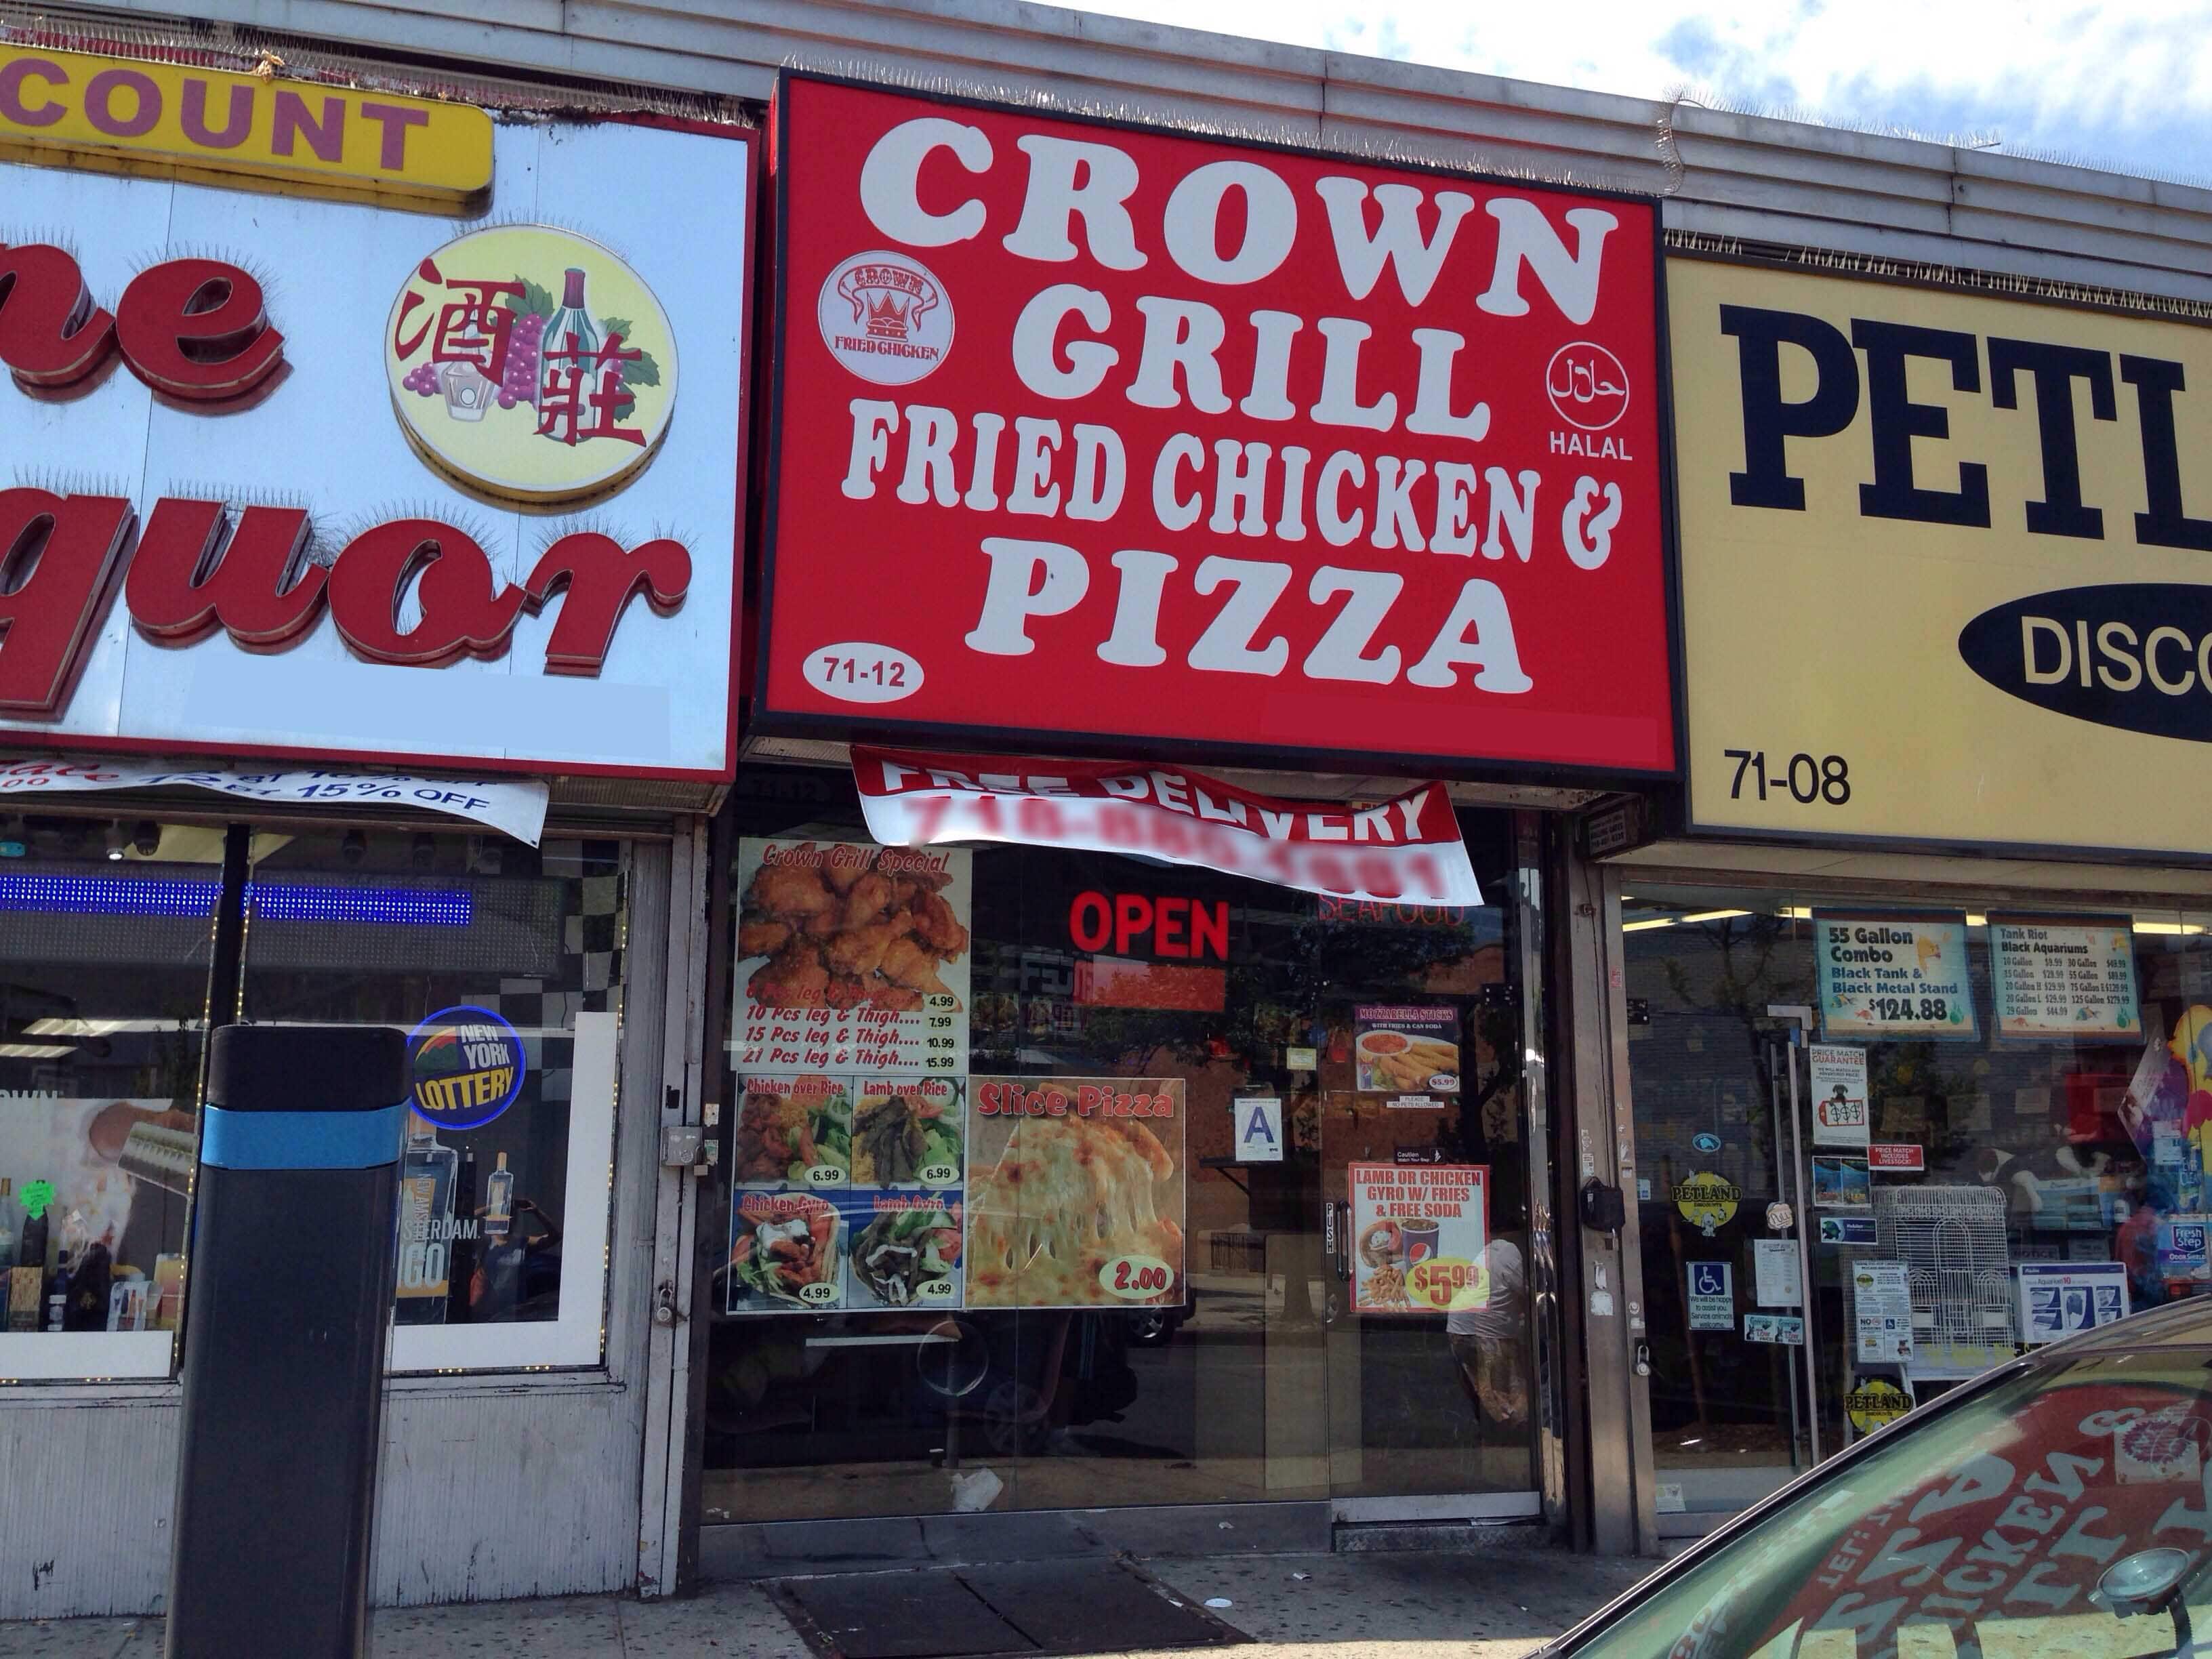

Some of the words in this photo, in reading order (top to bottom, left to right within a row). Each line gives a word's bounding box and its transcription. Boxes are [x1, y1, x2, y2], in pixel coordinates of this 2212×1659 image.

[0, 58, 428, 170] COUNT
[859, 117, 1619, 326] CROWN
[855, 268, 924, 294] CROWN
[835, 336, 876, 354] FRIED
[878, 341, 939, 361] CHICKEN
[1012, 283, 1491, 443] GRILL
[1550, 359, 1626, 403] حلال
[1550, 431, 1633, 461] HALAL
[842, 398, 1128, 522] FRIED
[1153, 432, 1541, 562] CHICKEN
[1562, 475, 1622, 571] &
[965, 536, 1534, 695] PIZZA
[822, 655, 906, 689] 71-12
[881, 760, 1080, 798] FREE
[1724, 750, 1851, 806] 71-08
[297, 783, 401, 799] 15%
[413, 789, 491, 810] OFF
[763, 844, 823, 868] Crown
[831, 845, 874, 869] Grill
[878, 848, 951, 877] Special
[1070, 890, 1229, 962] OPEN
[2001, 928, 2026, 939] Tank
[1829, 927, 1850, 944] 55
[1855, 927, 1914, 945] Gallon
[1830, 945, 1893, 962] Combo
[2001, 942, 2031, 953] Black
[2033, 942, 2089, 956] Aquariums
[2012, 957, 2032, 966] Gallon
[2077, 958, 2097, 968] Gallon
[1831, 967, 1871, 979] Black
[1874, 968, 1909, 979] Tank
[1912, 968, 1923, 979] &
[2013, 969, 2034, 979] Gallon
[2077, 970, 2098, 980] Gallon
[1832, 983, 1872, 994] Black
[1876, 983, 1915, 994] Metal
[1919, 983, 1959, 994] Stand
[2013, 982, 2035, 991] Gallon
[2079, 983, 2100, 992] Gallon
[929, 996, 954, 1006] 4.99
[2015, 994, 2036, 1004] Gallon
[2072, 996, 2083, 1004] 125
[2084, 995, 2104, 1004] Gallon
[746, 1004, 766, 1021] 10
[771, 1007, 802, 1021] Pcs
[805, 1007, 830, 1026] leg
[837, 1008, 850, 1021] &
[928, 1017, 952, 1027] 7.99
[1359, 1008, 1420, 1021] MOZZARELLA
[1420, 1008, 1454, 1021] STICKS
[1868, 998, 1948, 1021] $124.88
[2015, 1006, 2038, 1016] Gallon
[460, 1024, 499, 1042] NEW
[745, 1026, 764, 1042] 15
[770, 1027, 800, 1042] Pcs
[804, 1027, 830, 1046] leg
[836, 1028, 850, 1042] &
[926, 1038, 955, 1048] 10.99
[463, 1043, 510, 1070] YORK
[743, 1048, 764, 1063] 21
[770, 1049, 800, 1064] Pcs
[804, 1049, 829, 1068] leg
[835, 1050, 849, 1064] &
[925, 1057, 954, 1068] 15.99
[1811, 1055, 1864, 1065] GUARANTEE
[415, 1066, 514, 1111] LOTTERY
[746, 1078, 791, 1095] Chicken
[794, 1082, 818, 1096] over
[820, 1080, 844, 1096] Rice
[863, 1081, 894, 1096] Lamb
[896, 1083, 920, 1097] over
[924, 1080, 948, 1096] Rice
[977, 1082, 1068, 1117] Slice
[1078, 1085, 1174, 1118] Pizza
[1244, 1106, 1275, 1143] A
[813, 1170, 840, 1183] 6.99
[926, 1168, 951, 1180] 6.99
[1355, 1170, 1395, 1185] LAMB
[1397, 1170, 1417, 1185] OR
[1420, 1170, 1481, 1186] CHICKEN
[1367, 1187, 1406, 1202] GYRO
[1408, 1187, 1429, 1202] W/
[1431, 1187, 1470, 1202] FRIES
[1672, 1185, 1743, 1202] PETLAND
[742, 1194, 795, 1212] Chicken
[873, 1195, 907, 1210] Lamb
[911, 1195, 944, 1213] Gyro
[1376, 1203, 1387, 1218] &
[1389, 1203, 1421, 1218] FREE
[1424, 1203, 1462, 1218] SODA
[2175, 1228, 2203, 1237] Fresh
[2177, 1237, 2202, 1248] Step
[1114, 1261, 1166, 1290] 2.00
[802, 1288, 830, 1299] 4.99
[927, 1284, 951, 1295] 4.99
[1844, 1393, 1914, 1410] PETLAND
